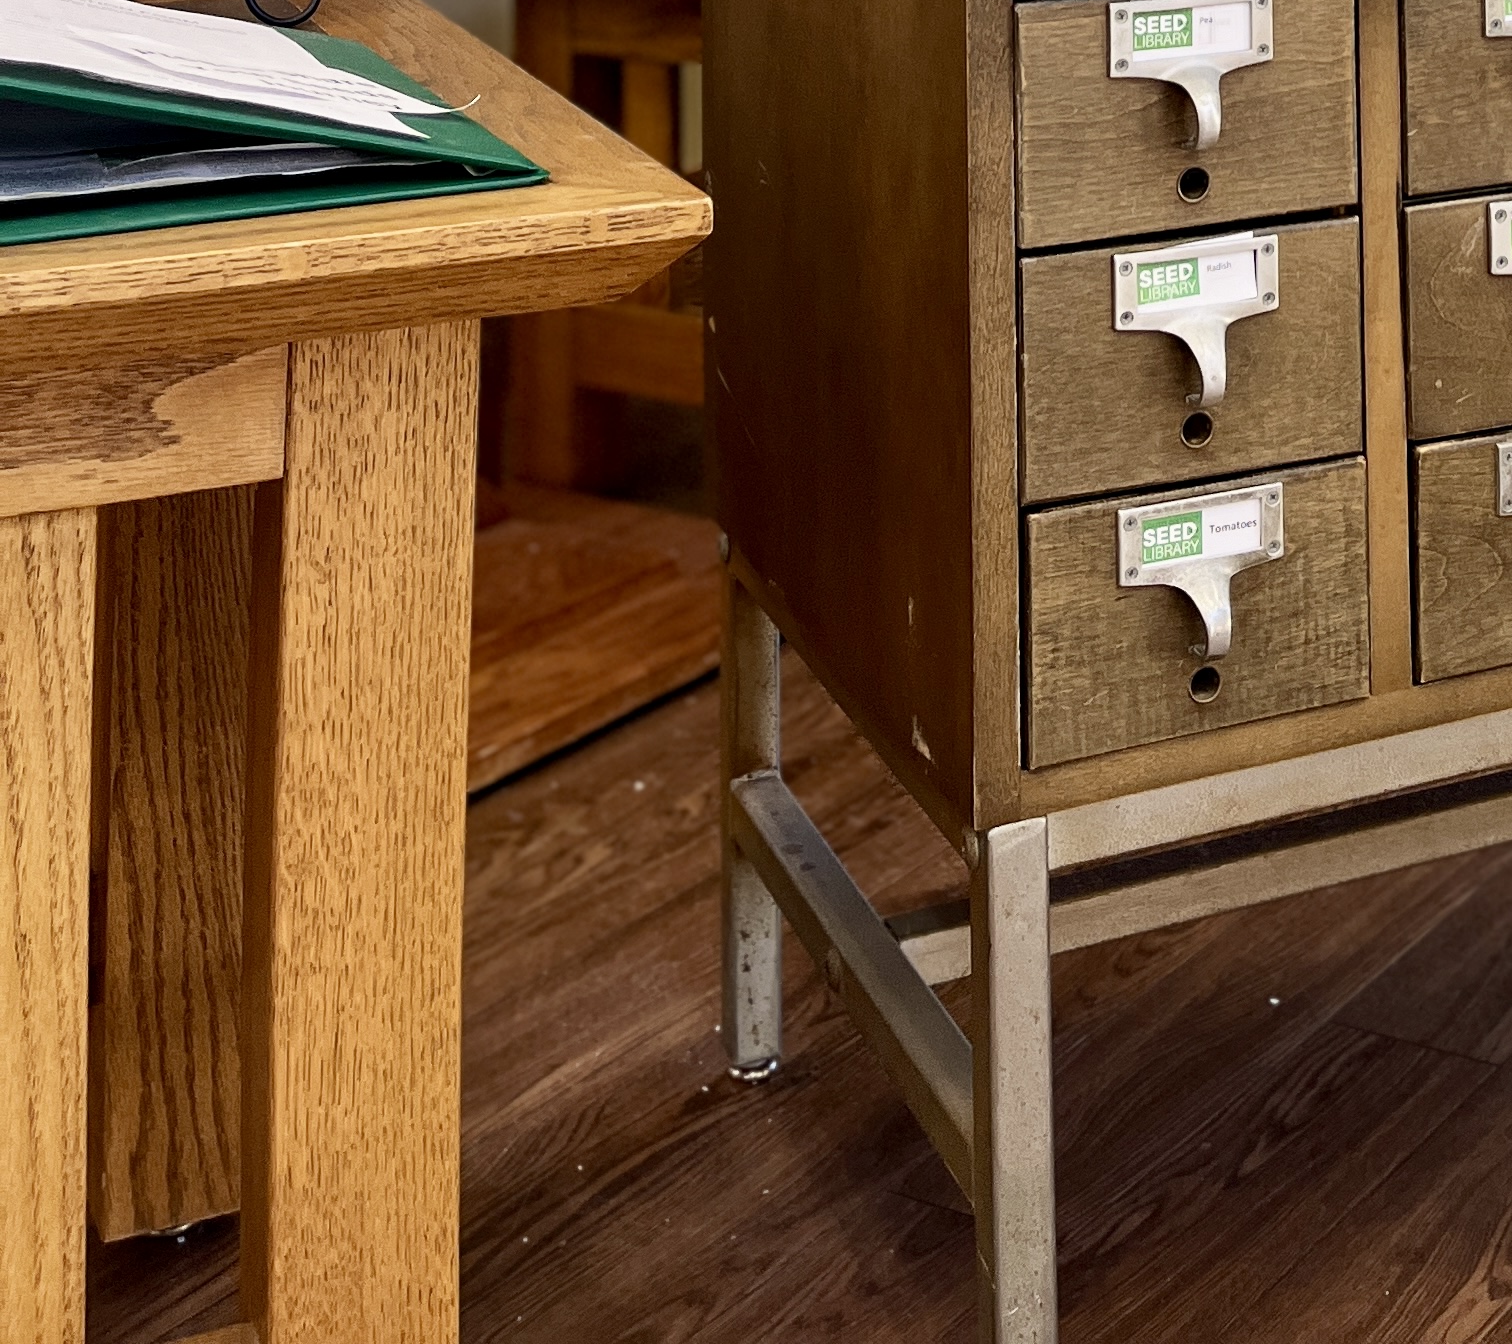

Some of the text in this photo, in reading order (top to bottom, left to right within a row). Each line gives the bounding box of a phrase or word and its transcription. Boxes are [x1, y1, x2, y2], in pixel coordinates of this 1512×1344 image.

[1134, 14, 1187, 35] SEED
[1135, 31, 1190, 49] LIBRARY
[1139, 262, 1194, 288] SEED
[1207, 261, 1231, 272] Radish
[1141, 281, 1196, 301] LIBRARY
[1144, 522, 1197, 546] SEED
[1210, 519, 1257, 534] Tomatoes
[1144, 539, 1199, 561] LIBRARY
